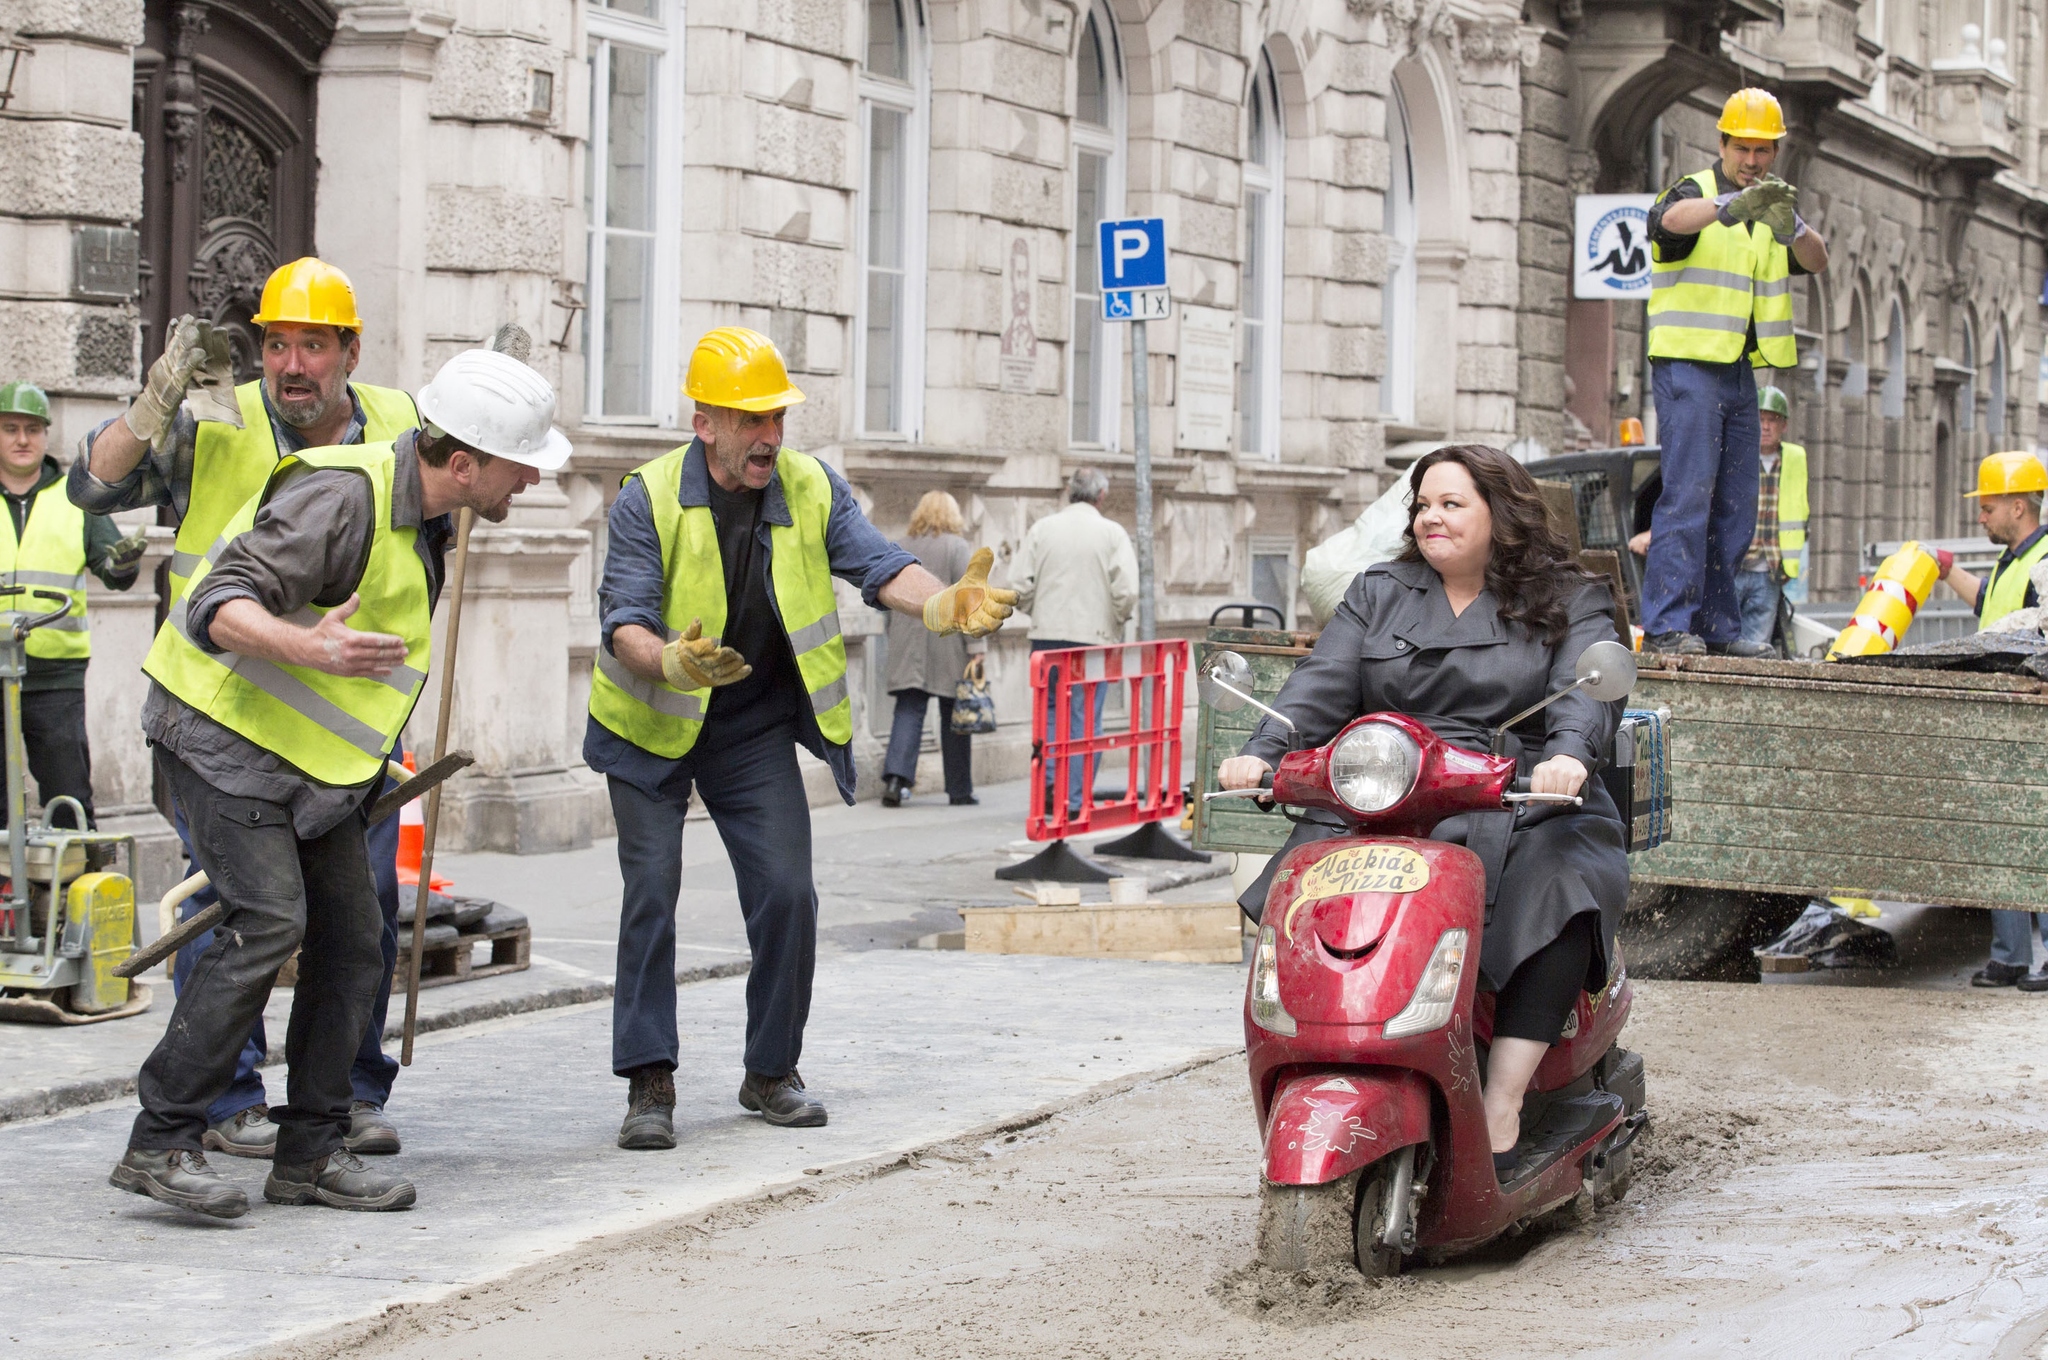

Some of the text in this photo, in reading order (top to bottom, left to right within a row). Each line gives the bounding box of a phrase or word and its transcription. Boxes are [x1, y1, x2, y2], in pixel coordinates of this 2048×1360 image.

[1113, 228, 1151, 279] P
[1140, 292, 1147, 315] 1
[1312, 848, 1417, 881] Kackiás
[1327, 871, 1405, 893] Pizza
[1563, 1013, 1578, 1031] 30
